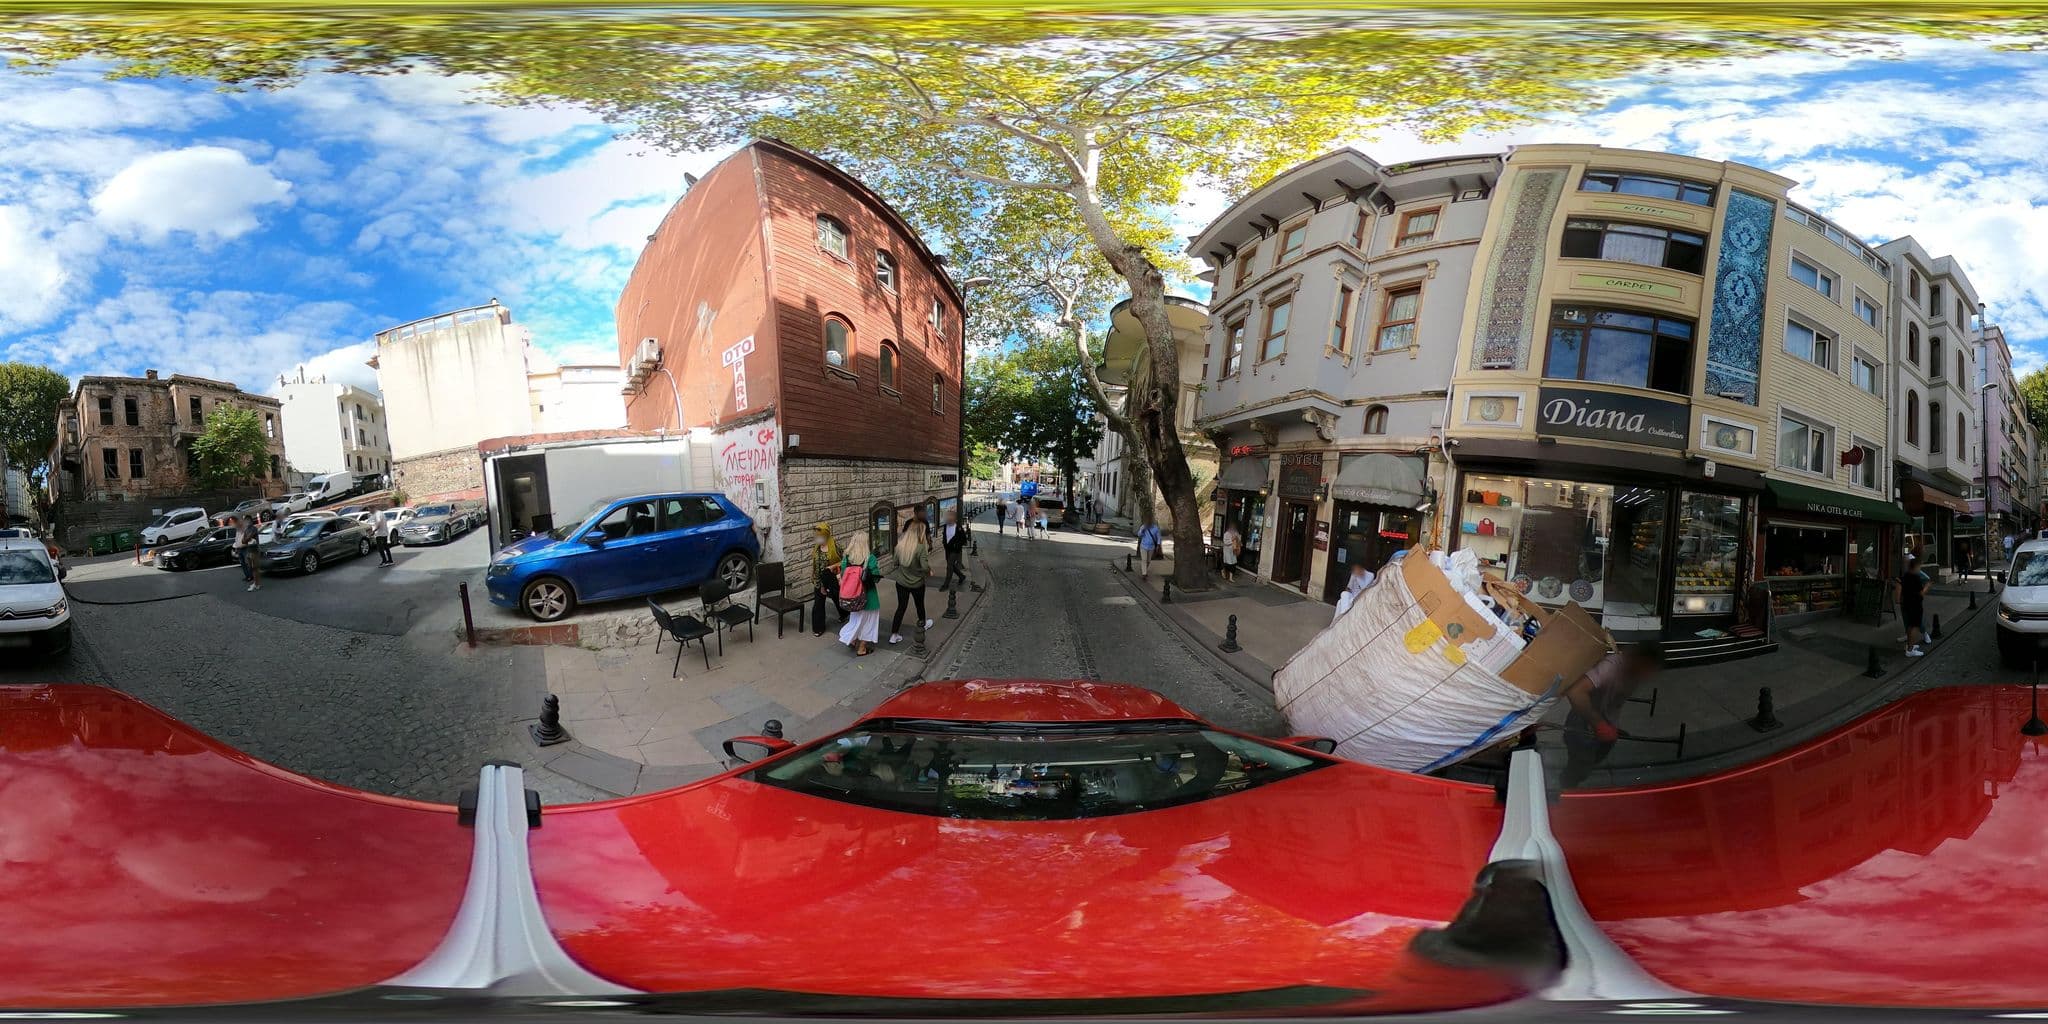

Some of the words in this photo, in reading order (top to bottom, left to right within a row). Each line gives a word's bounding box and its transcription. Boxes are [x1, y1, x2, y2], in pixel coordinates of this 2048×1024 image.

[1606, 280, 1653, 291] CARPET
[724, 340, 752, 363] OTO
[735, 360, 746, 410] PARK
[1543, 398, 1646, 433] Diana
[726, 447, 776, 471] MEYDAN
